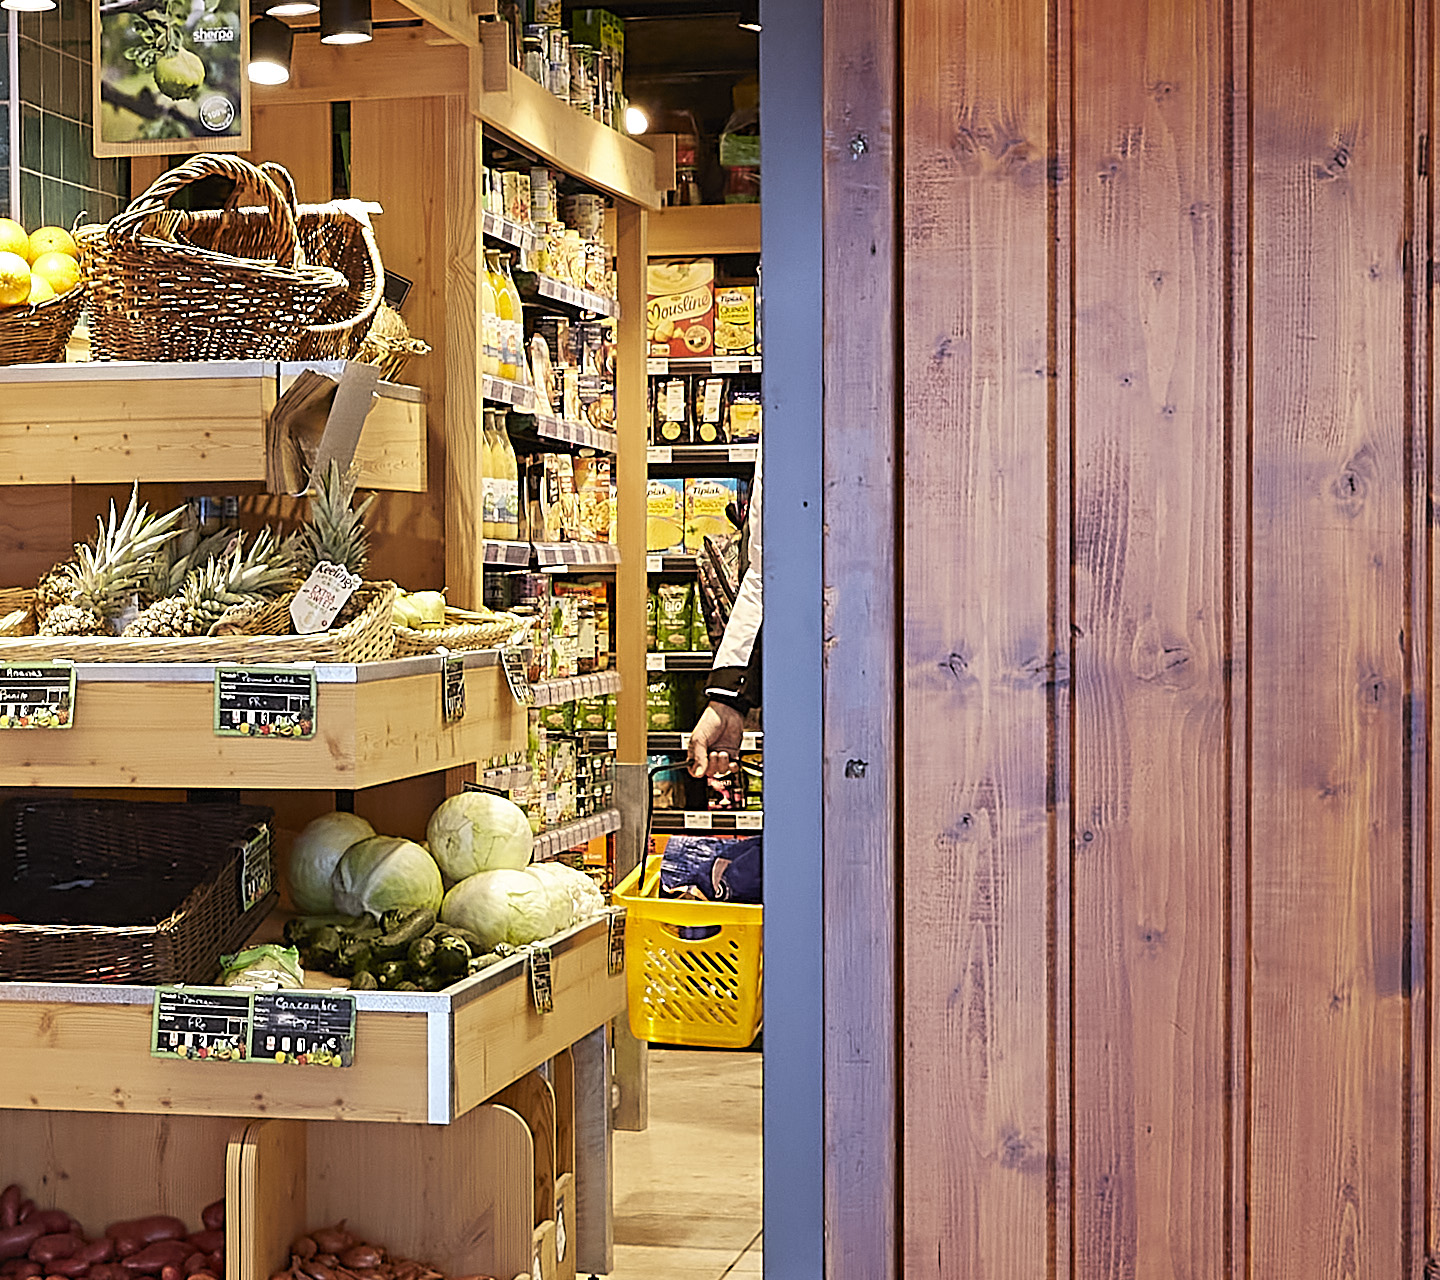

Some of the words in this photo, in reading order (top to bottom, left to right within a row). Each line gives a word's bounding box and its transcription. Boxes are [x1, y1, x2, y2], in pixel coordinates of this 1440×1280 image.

[193, 28, 234, 41] sherpa
[647, 294, 709, 320] Mousline
[647, 487, 667, 497] piak
[693, 487, 720, 496] Tipiak
